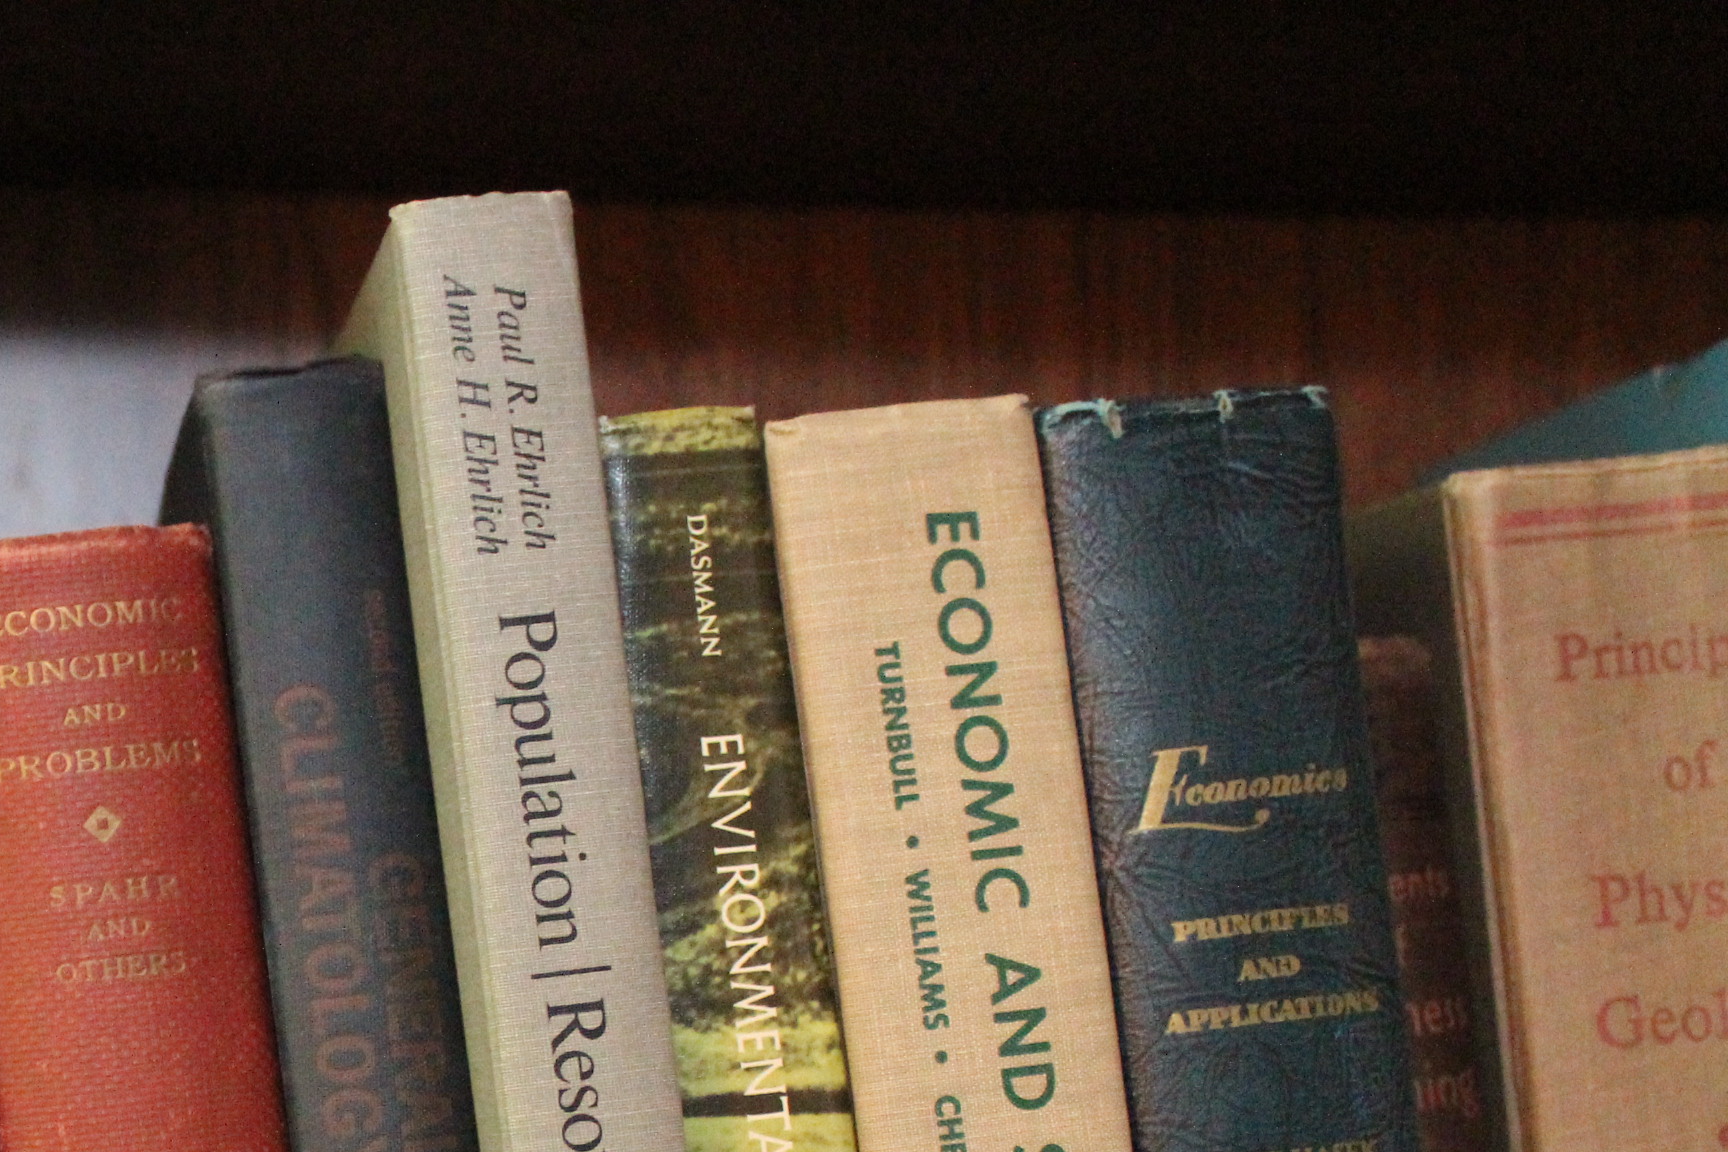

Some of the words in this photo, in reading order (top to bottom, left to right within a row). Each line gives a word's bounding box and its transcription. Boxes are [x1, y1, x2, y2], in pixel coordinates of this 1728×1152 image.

[443, 274, 477, 362] Anne
[494, 284, 535, 366] Paul
[456, 378, 492, 418] H.
[505, 378, 539, 414] R.
[462, 430, 508, 556] Ehrlich
[510, 426, 556, 551] Ehrlich
[686, 514, 722, 657] DASMANN
[63, 702, 128, 727] AND
[495, 609, 587, 951] Population
[1127, 745, 1349, 835] Economics
[1663, 739, 1719, 792] of
[874, 641, 920, 811] TURNBULL
[904, 869, 950, 1031] WILLIAMS
[926, 511, 1030, 913] ECONOMIC
[985, 953, 1055, 1111] AND
[87, 916, 152, 941] AND
[1171, 903, 1350, 942] PRINCIPLES
[55, 950, 187, 986] OTHERS
[1236, 954, 1302, 983] AND
[1164, 988, 1380, 1034] APPLICATIONS
